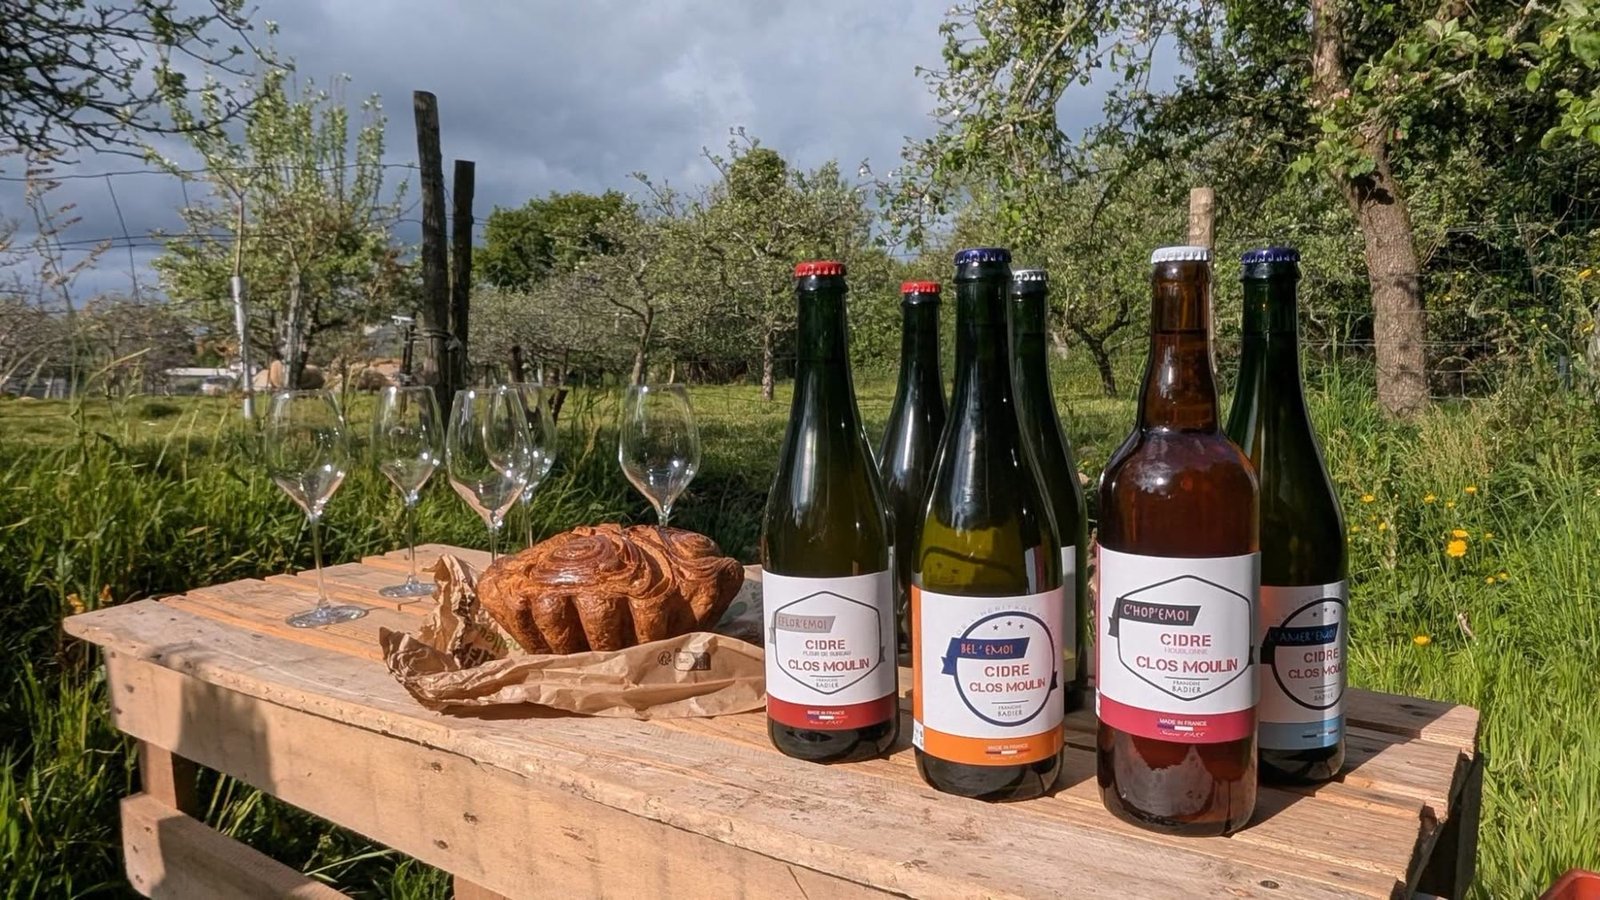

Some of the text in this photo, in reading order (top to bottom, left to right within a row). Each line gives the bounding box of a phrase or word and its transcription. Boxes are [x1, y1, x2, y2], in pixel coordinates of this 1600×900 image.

[805, 639, 846, 651] CIDRE
[1160, 633, 1212, 648] CIDRE
[1303, 647, 1339, 664] CIDRE
[788, 658, 870, 672] CLOS MOULIN
[984, 664, 1030, 678] CIDRE
[1136, 655, 1238, 674] CLOS MOULIN
[1288, 667, 1320, 680] CLOS
[969, 677, 1046, 693] CLOS MOULIN
[1172, 686, 1202, 694] BADIER
[998, 709, 1023, 717] BADIER
[1159, 718, 1176, 726] MADE
[1184, 720, 1208, 728] FRANCE
